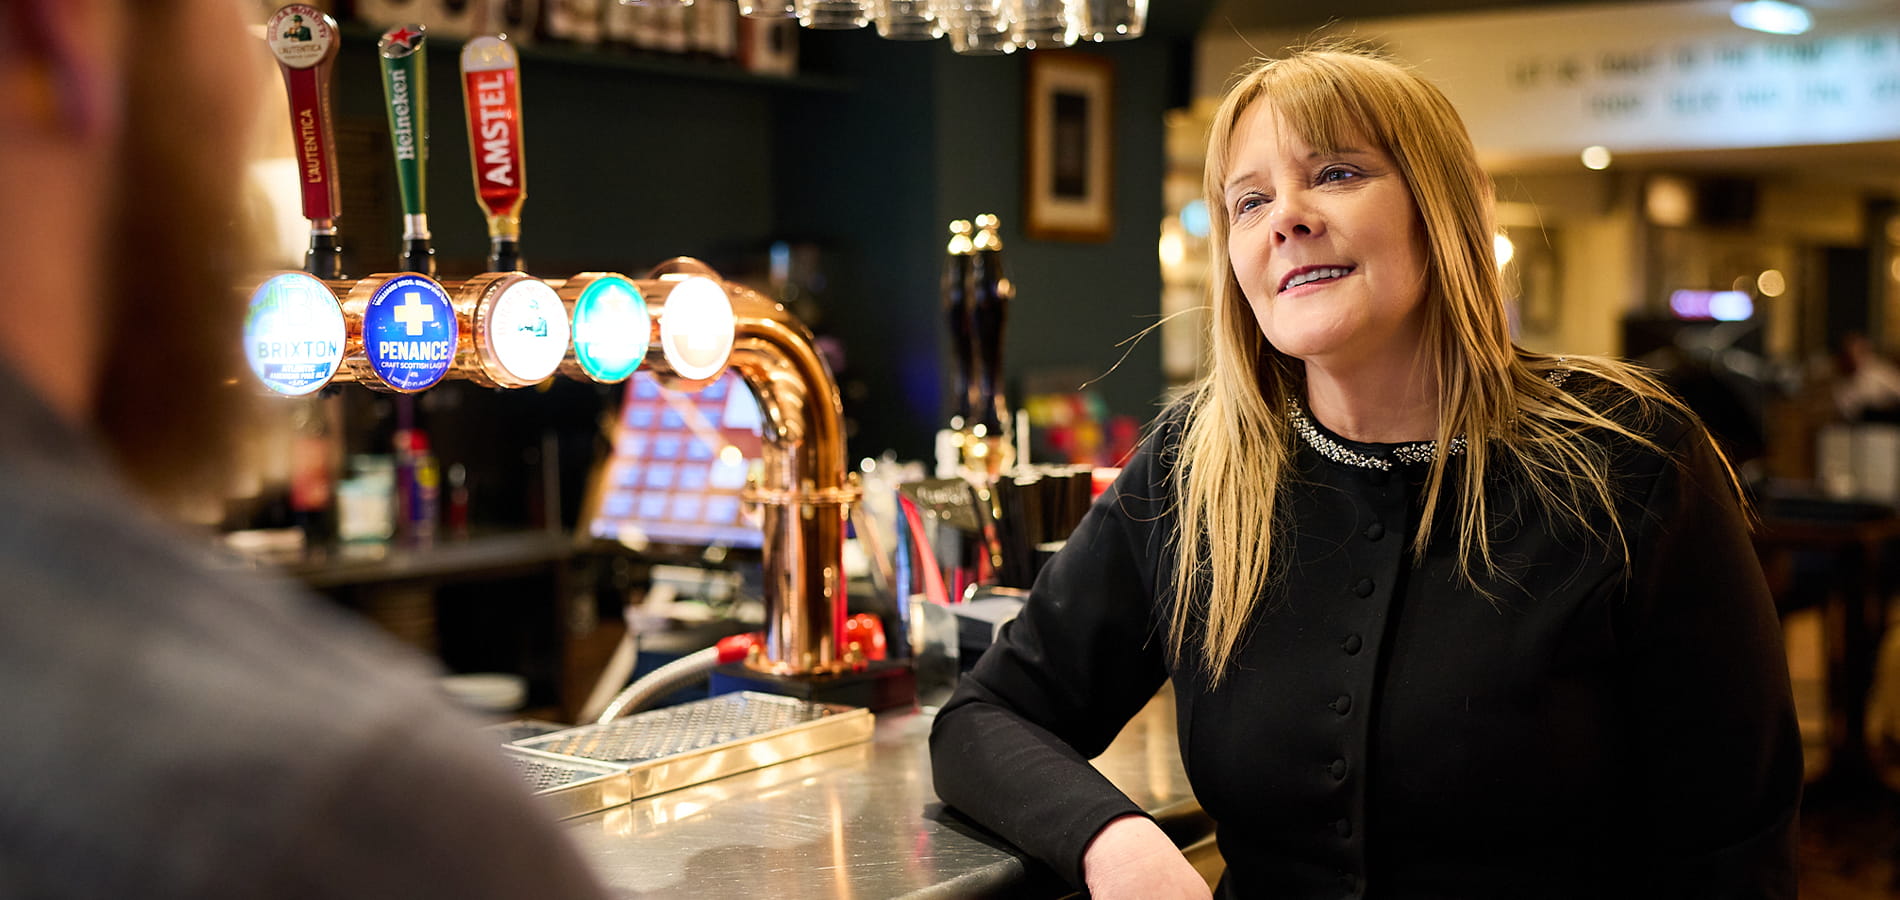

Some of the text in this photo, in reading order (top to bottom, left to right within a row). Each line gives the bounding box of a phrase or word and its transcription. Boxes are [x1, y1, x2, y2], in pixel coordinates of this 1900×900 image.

[391, 68, 415, 161] Heineken
[477, 73, 514, 187] AMSTEL
[299, 108, 323, 184] L'AUTENTICA
[257, 340, 337, 359] BRIXTON
[379, 340, 449, 361] PENANCE
[380, 361, 447, 370] CRAFT SCOTTISH LAGER
